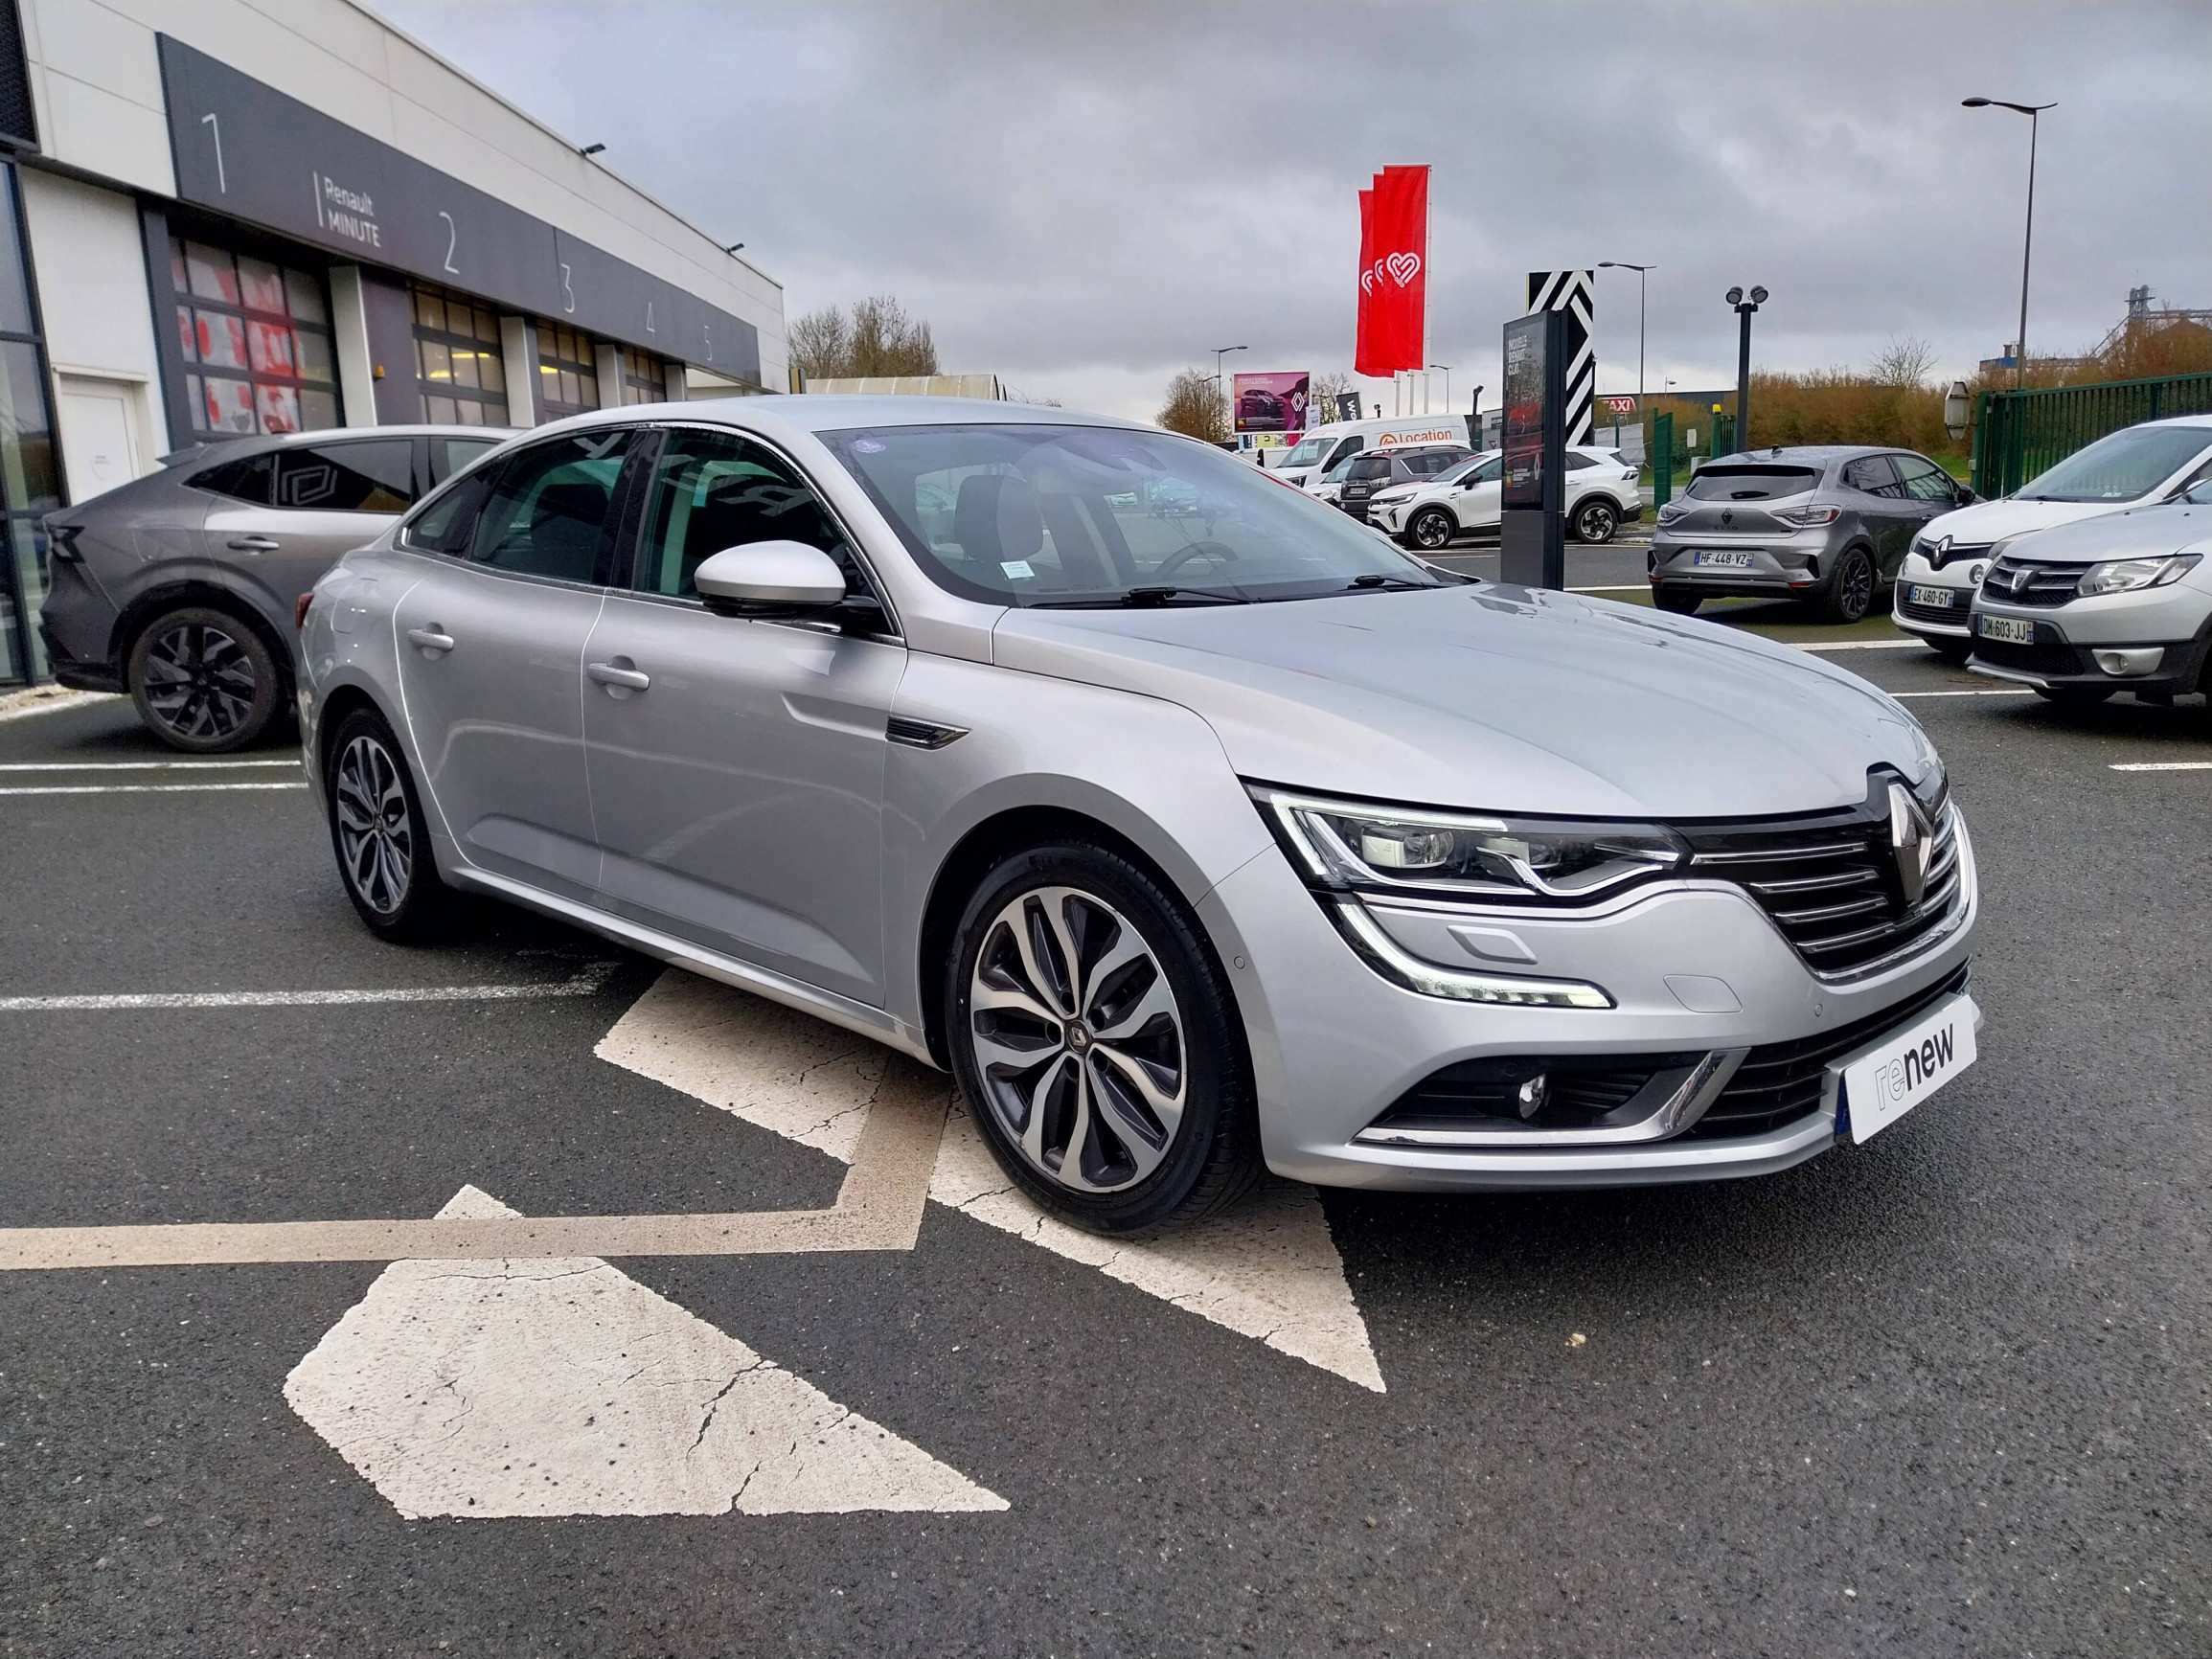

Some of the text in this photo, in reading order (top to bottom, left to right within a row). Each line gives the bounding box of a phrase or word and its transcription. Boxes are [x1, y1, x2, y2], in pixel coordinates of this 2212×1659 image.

[202, 113, 226, 193] 1
[324, 176, 375, 216] Renault
[326, 209, 381, 247] MINUTE
[439, 211, 460, 275] 2
[560, 262, 575, 314] 3
[646, 302, 656, 341] 4
[703, 325, 713, 362] 5
[1399, 429, 1452, 443] Location
[1700, 553, 1747, 565] HF-448-VZ
[1914, 587, 1950, 605] EX-460-GY
[1983, 618, 2026, 641] DM-603-JJ
[1875, 1022, 1953, 1112] renew
